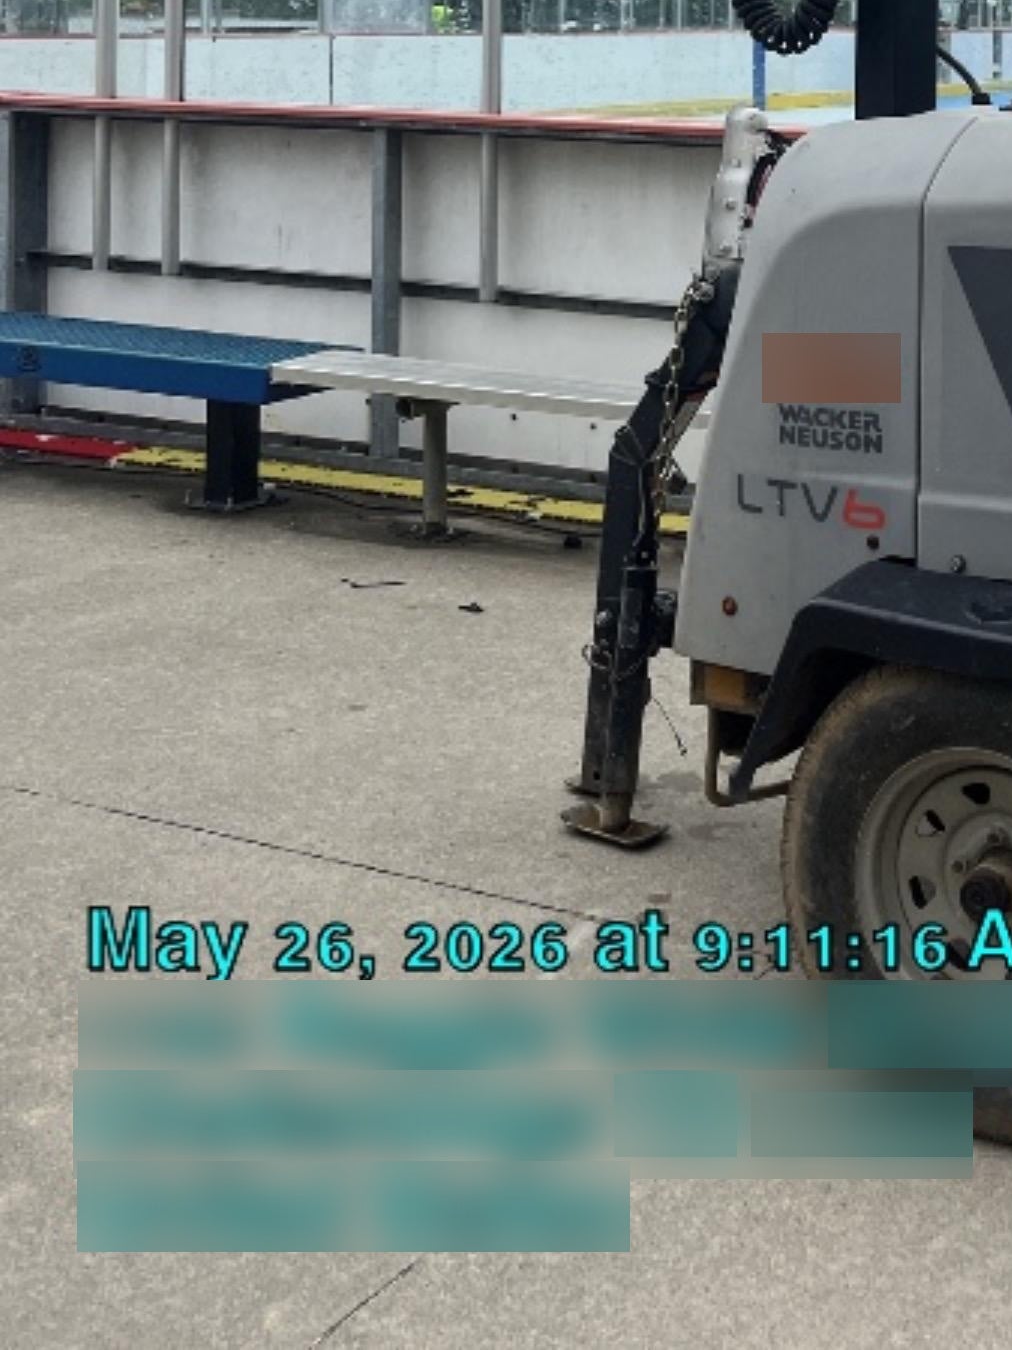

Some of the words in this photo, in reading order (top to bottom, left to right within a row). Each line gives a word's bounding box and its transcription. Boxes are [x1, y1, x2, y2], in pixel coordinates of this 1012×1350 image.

[777, 403, 883, 433] WACKER
[779, 426, 883, 454] NEUSON
[737, 473, 886, 530] LTV6
